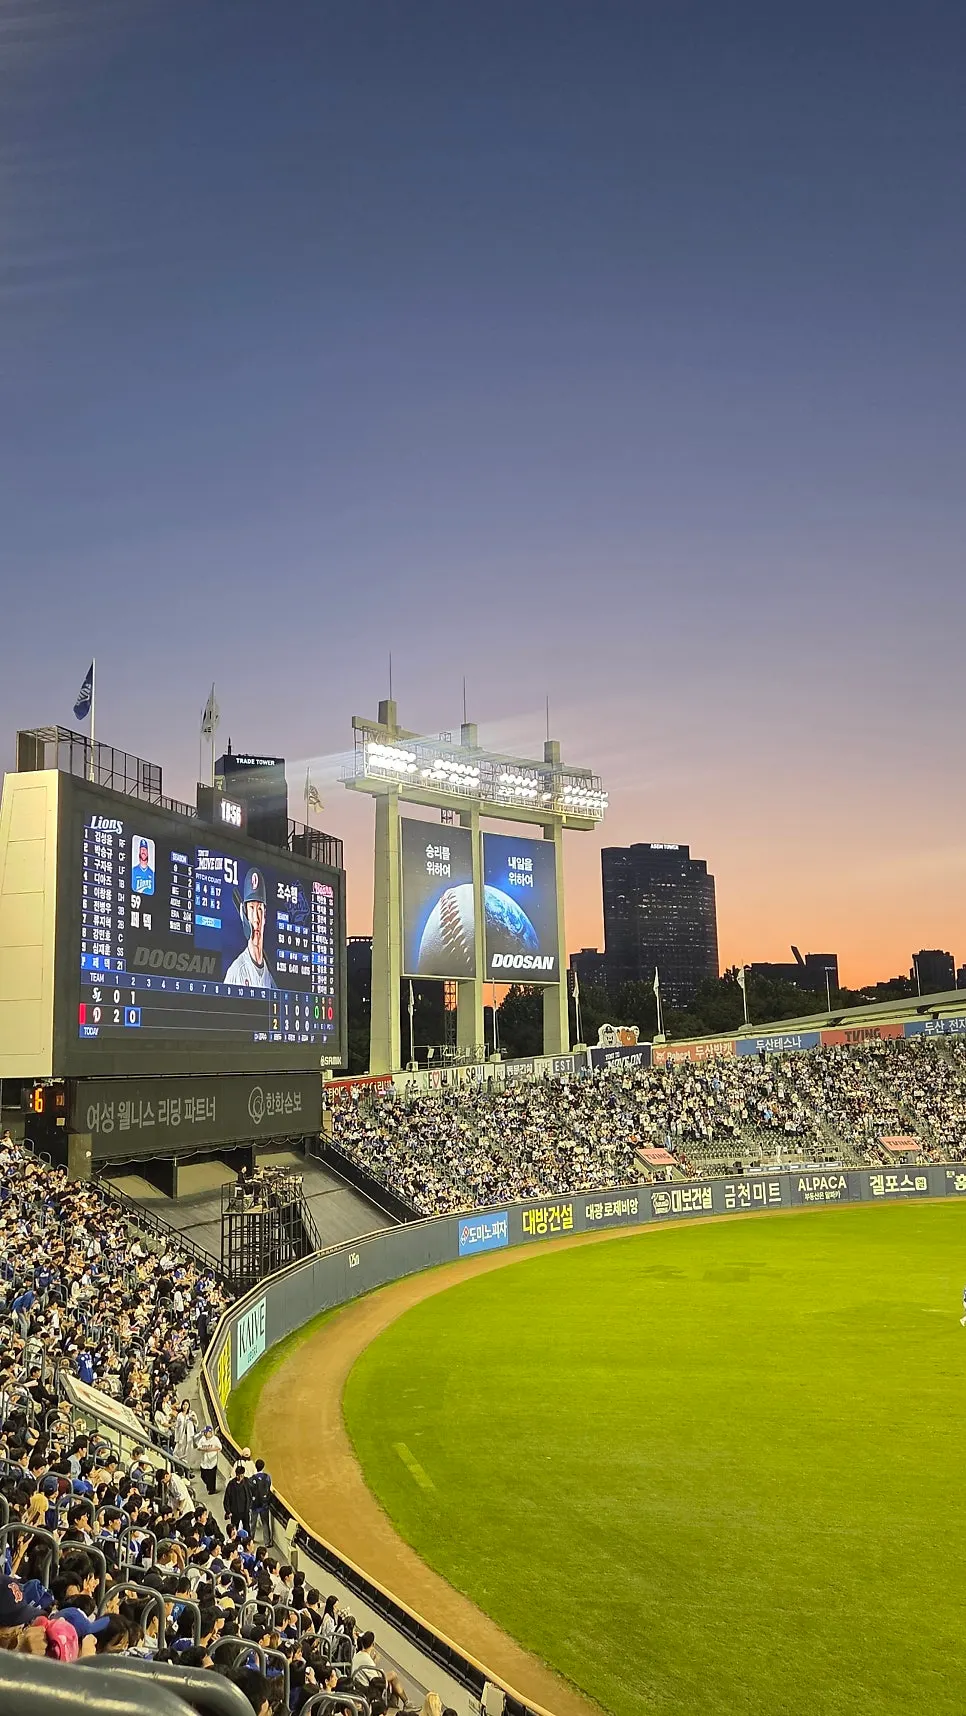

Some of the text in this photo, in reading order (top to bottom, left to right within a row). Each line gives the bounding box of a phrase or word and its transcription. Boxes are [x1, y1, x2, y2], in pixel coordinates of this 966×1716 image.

[91, 816, 124, 834] Lions
[426, 844, 450, 861] 승리를
[224, 858, 238, 885] 51
[426, 861, 451, 877] 위하여
[508, 856, 533, 872] 내일을
[508, 872, 533, 888] 위하여
[131, 894, 141, 910] 59
[202, 898, 208, 907] 21
[133, 946, 216, 974] DOOSAN
[492, 954, 554, 970] DOOSAN
[90, 973, 104, 982] TEAM
[132, 977, 135, 985] 2
[147, 979, 151, 987] 3
[161, 980, 165, 988] 4
[176, 982, 179, 990] 5
[190, 983, 193, 991] 6
[238, 988, 244, 996] 10
[261, 990, 266, 998] 12
[114, 989, 120, 1003] 0
[131, 991, 135, 1004] 1
[274, 1004, 277, 1014] 1
[285, 1005, 288, 1015] 1
[295, 1005, 299, 1016] 0
[305, 1006, 309, 1017] 0
[314, 1006, 319, 1019] 0
[322, 1006, 325, 1019] 1
[328, 1007, 333, 1020] 0
[114, 1009, 120, 1022] 2
[130, 1010, 136, 1023] 0
[273, 1019, 278, 1029] 2
[285, 1020, 289, 1030] 3
[295, 1021, 300, 1031] 0
[305, 1021, 309, 1031] 0
[924, 1020, 945, 1035] 두산
[84, 1027, 99, 1035] TODAY
[845, 1028, 880, 1042] TVING
[756, 1035, 801, 1053] 두산테스나
[555, 1060, 571, 1072] EST
[266, 1091, 302, 1116] 한화손보
[87, 1096, 216, 1133] 여성 웰니스 리딩 파트너
[798, 1175, 847, 1192] ALPACA
[671, 1187, 712, 1212] 대보건설
[724, 1182, 781, 1208] 금천미트
[804, 1192, 824, 1201] 부동산은
[586, 1202, 603, 1220] 대광
[604, 1198, 638, 1216] 로제비앙
[522, 1204, 574, 1235] 대방건설
[469, 1220, 507, 1244] 도미노피자
